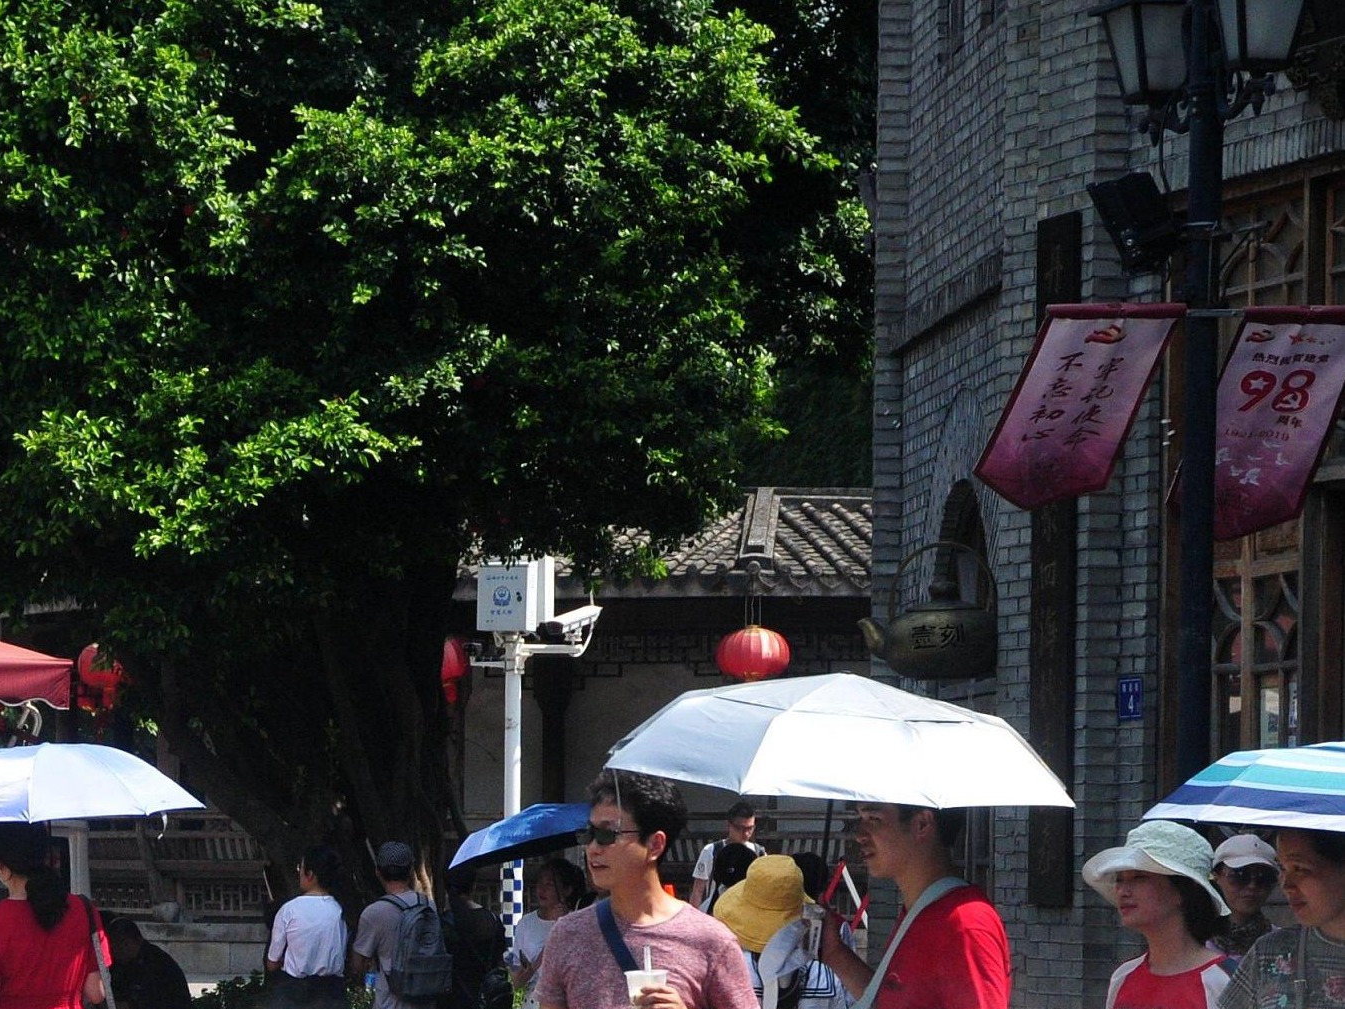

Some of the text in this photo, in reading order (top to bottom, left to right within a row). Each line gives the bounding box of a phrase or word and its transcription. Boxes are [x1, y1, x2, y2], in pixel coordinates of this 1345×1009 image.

[1021, 351, 1084, 441] 不忘初心
[1238, 369, 1316, 412] 98
